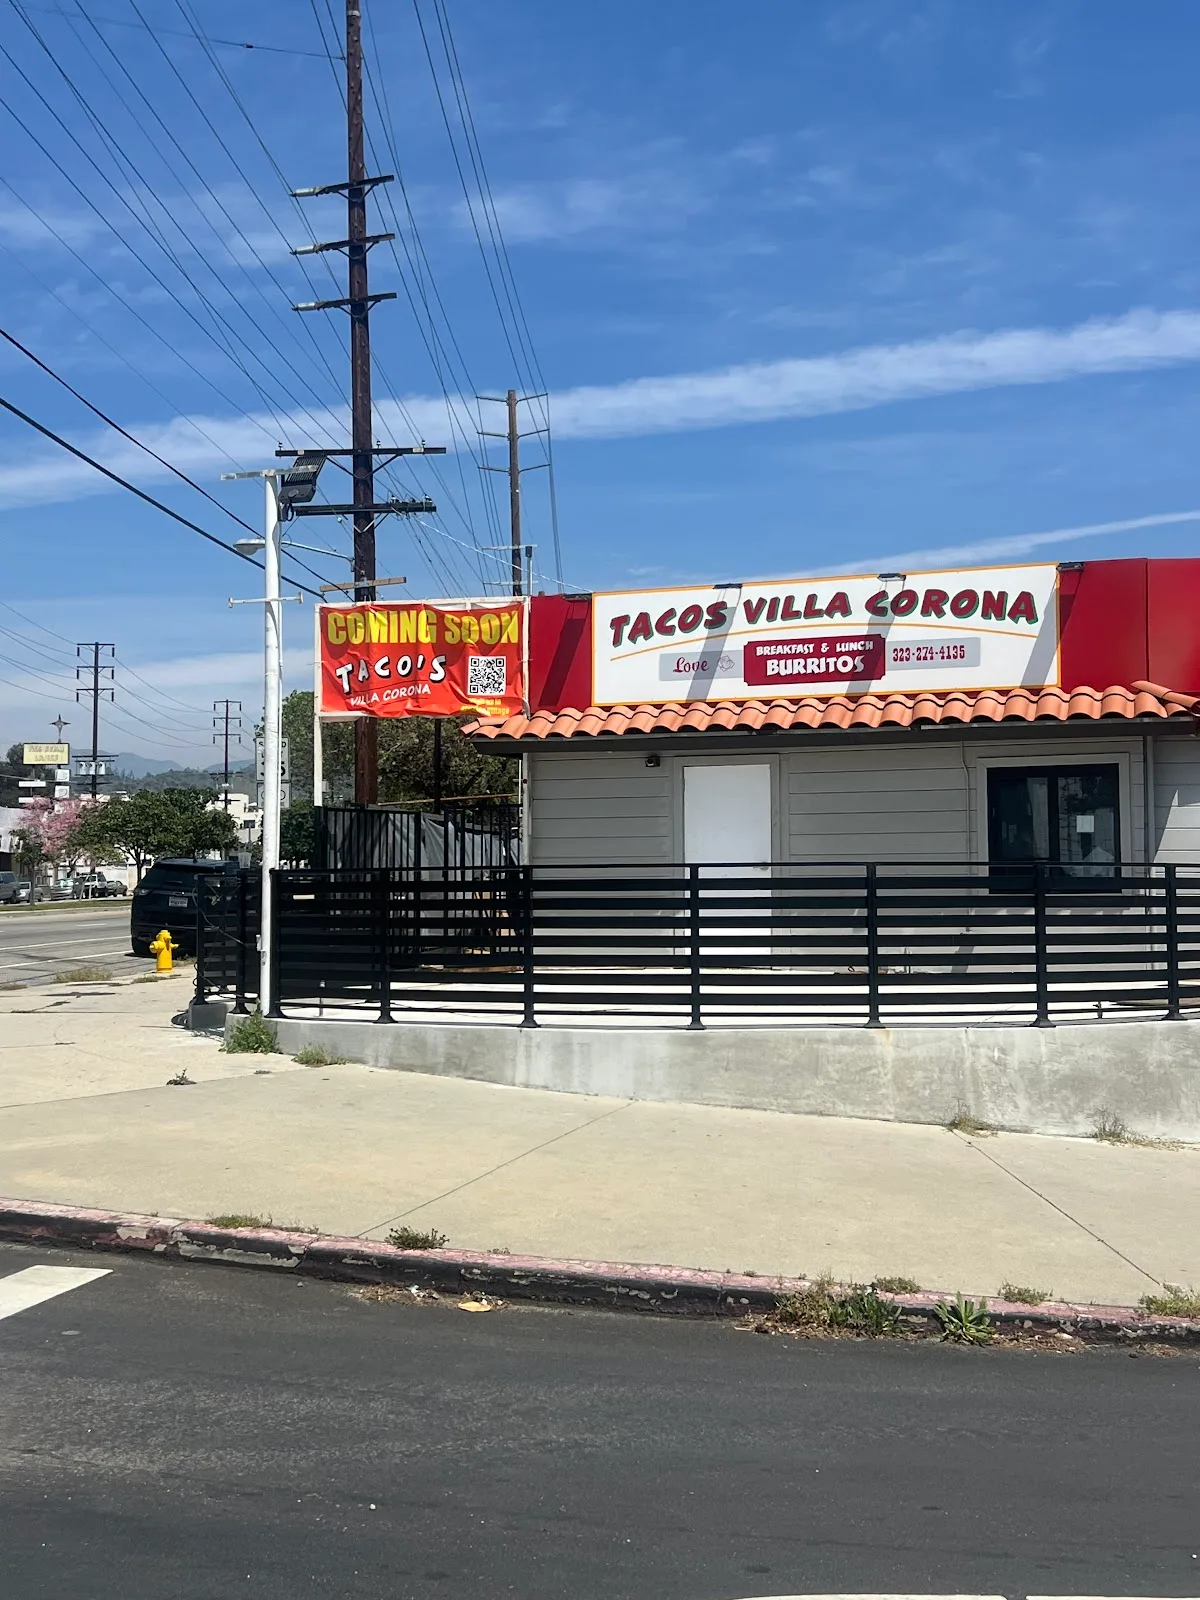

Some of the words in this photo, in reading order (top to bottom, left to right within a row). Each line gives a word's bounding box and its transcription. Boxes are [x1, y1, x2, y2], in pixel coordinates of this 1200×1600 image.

[327, 609, 437, 645] COMING
[444, 611, 519, 645] SOON
[610, 601, 728, 648] TACOS
[743, 591, 853, 625] VILLA
[865, 589, 1039, 625] CORONA
[756, 643, 815, 656] BREAKFAST
[821, 643, 830, 652] &
[836, 641, 873, 653] LUNCH
[892, 645, 965, 662] 323-274-4135
[335, 654, 447, 695] TACO'S
[673, 657, 710, 673] Love
[766, 655, 865, 676] BURRITOS
[350, 693, 380, 706] VILLA
[383, 684, 432, 701] CORONA
